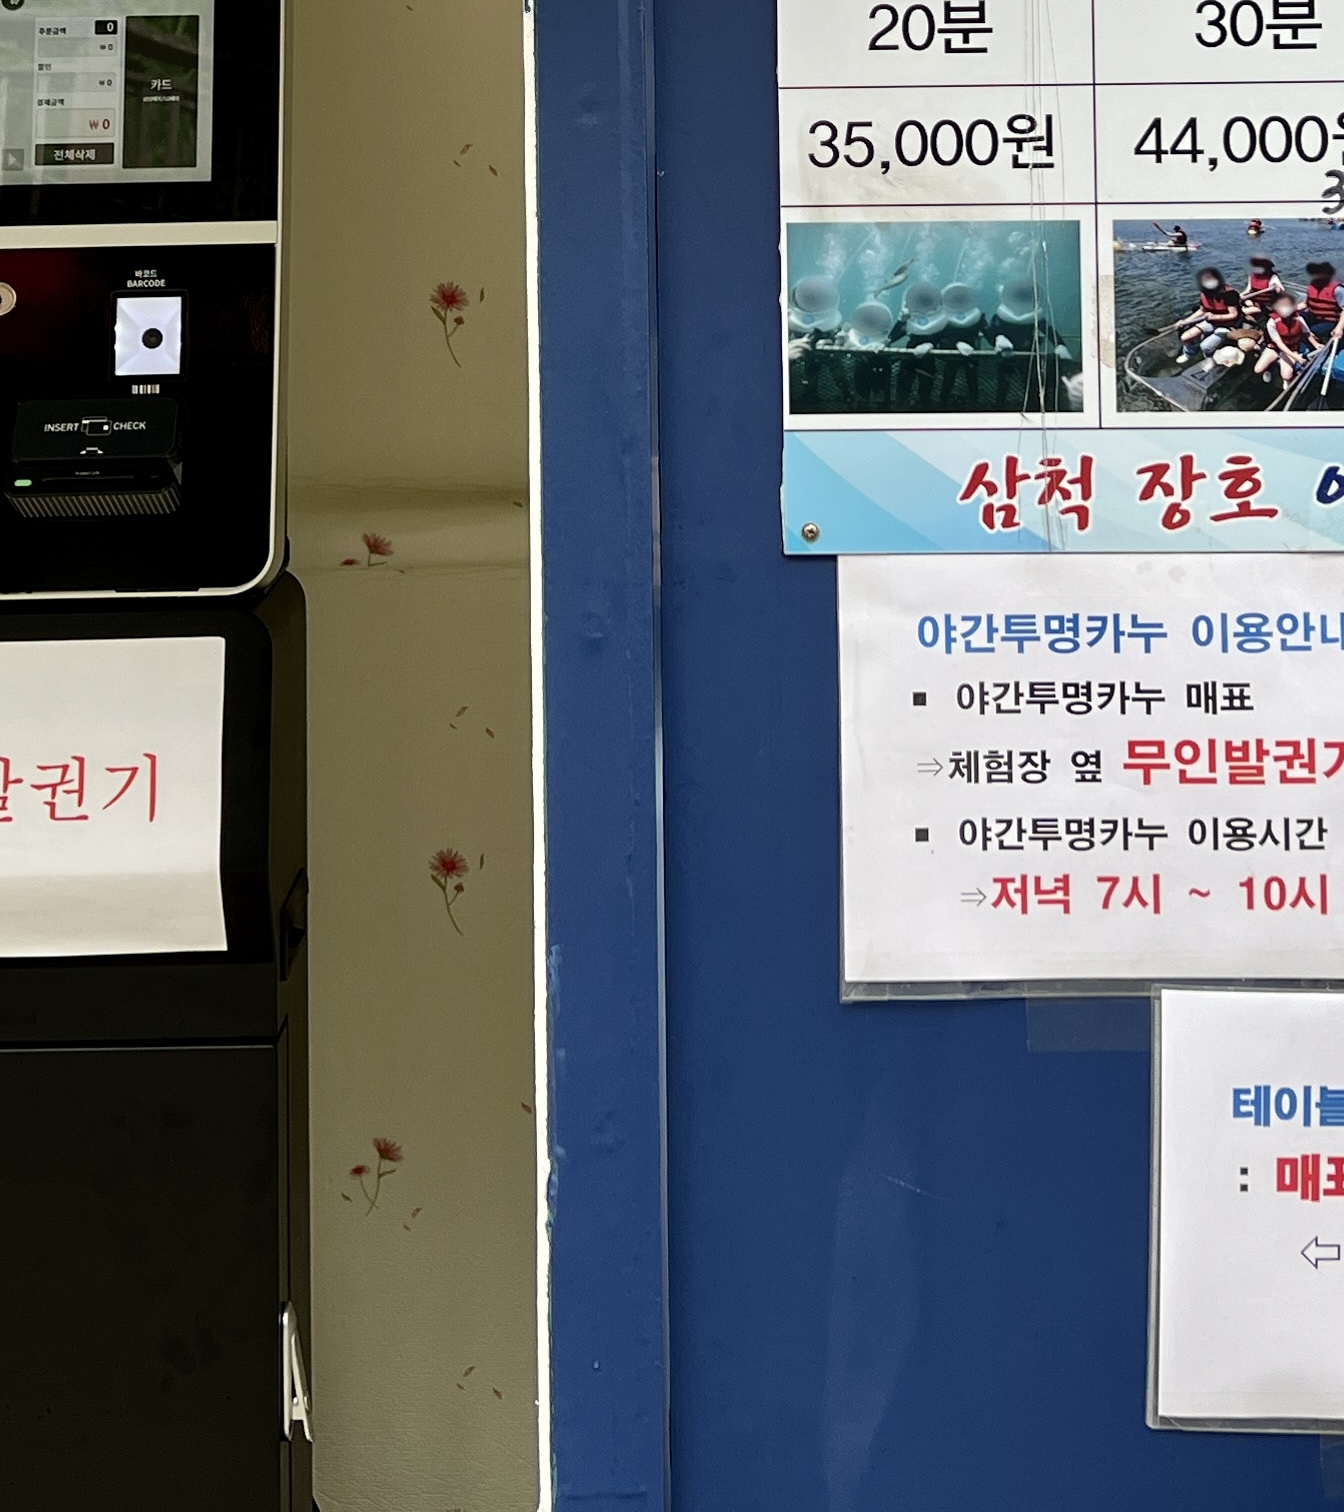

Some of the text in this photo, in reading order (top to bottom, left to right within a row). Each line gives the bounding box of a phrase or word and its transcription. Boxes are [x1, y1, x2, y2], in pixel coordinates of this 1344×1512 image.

[867, 0, 994, 54] 20분
[151, 79, 173, 91] 카드
[53, 149, 96, 161] 전체삭제
[808, 114, 1056, 173] 35,000원
[127, 279, 166, 288] BARCODE
[44, 421, 146, 432] INSERT CHECK
[959, 454, 1096, 532] 삼척
[1136, 453, 1279, 531] 장호
[918, 613, 1167, 654] 야간투명카누
[957, 681, 1254, 715] 야간투명카누 매표
[949, 750, 1050, 784] 체험장
[1071, 750, 1102, 782] 옆
[960, 817, 1327, 851] 야간투명카누 이용시간
[992, 874, 1070, 914] 저녁
[1097, 874, 1160, 914] 7시
[1239, 874, 1327, 915] 10시
